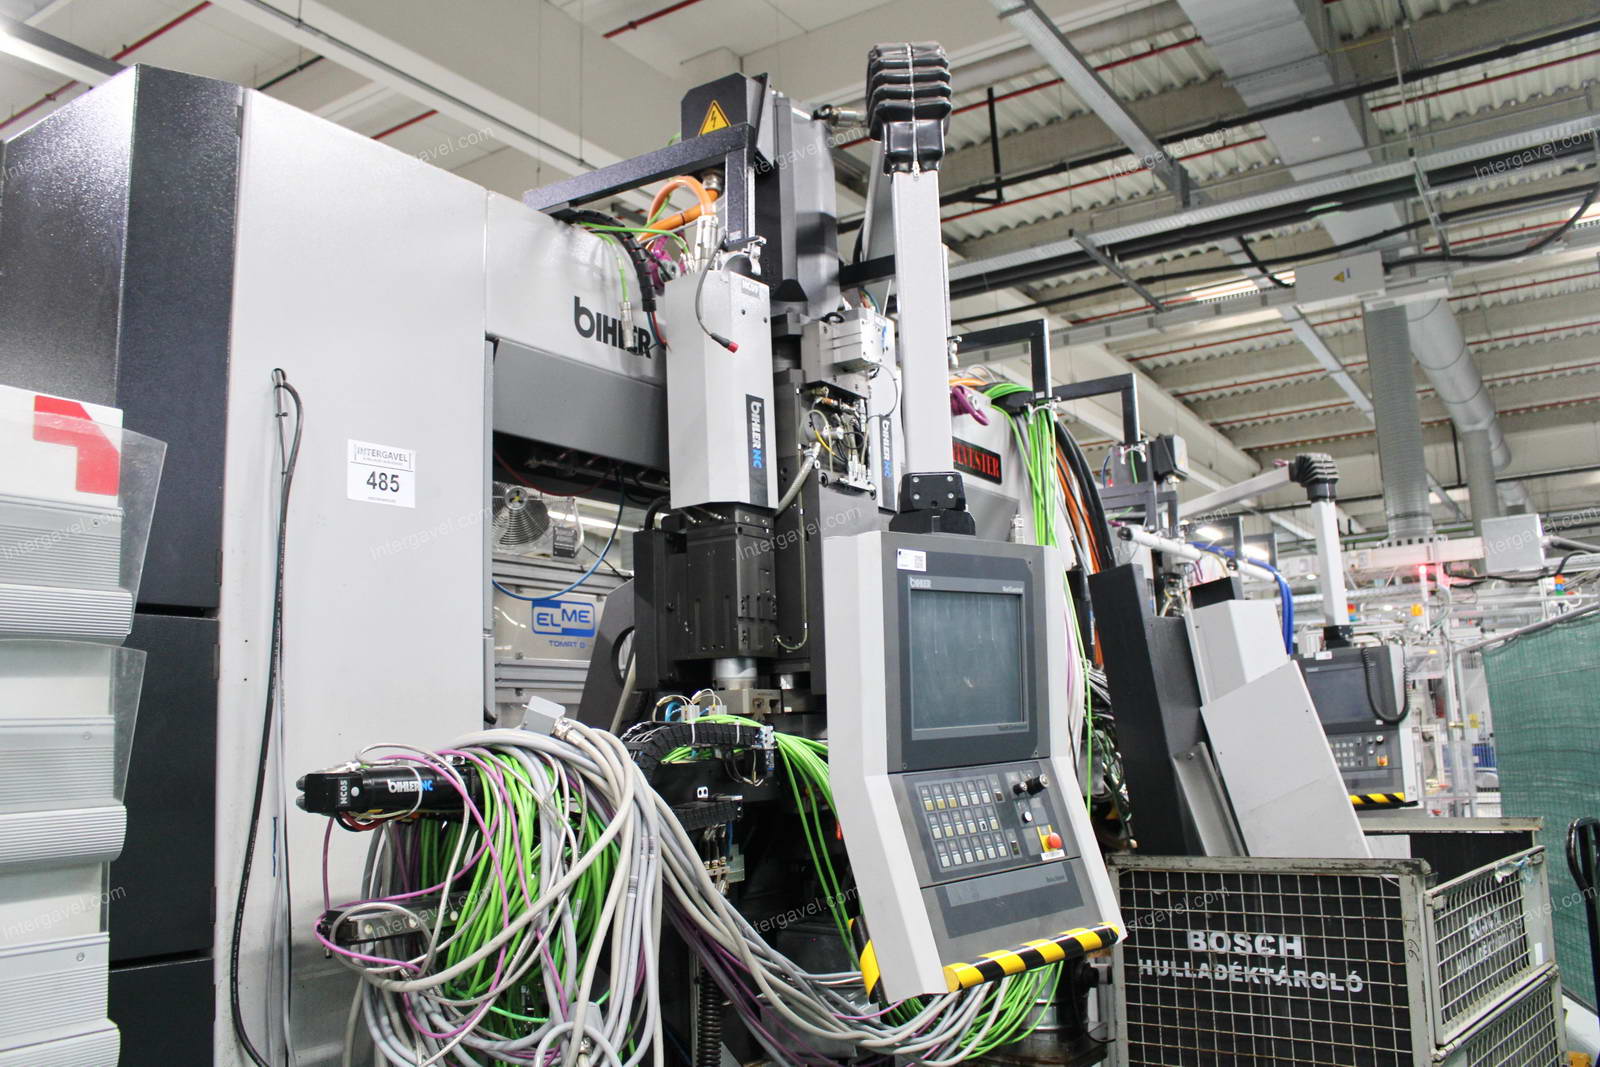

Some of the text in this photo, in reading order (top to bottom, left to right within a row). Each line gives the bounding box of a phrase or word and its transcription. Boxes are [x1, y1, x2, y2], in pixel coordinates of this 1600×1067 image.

[357, 447, 408, 463] INTERGAVEL
[366, 470, 400, 493] 485
[536, 608, 590, 627] ELME
[1187, 929, 1302, 959] BOSCH
[1138, 959, 1364, 993] HULLADÉKTÁROLÓ
